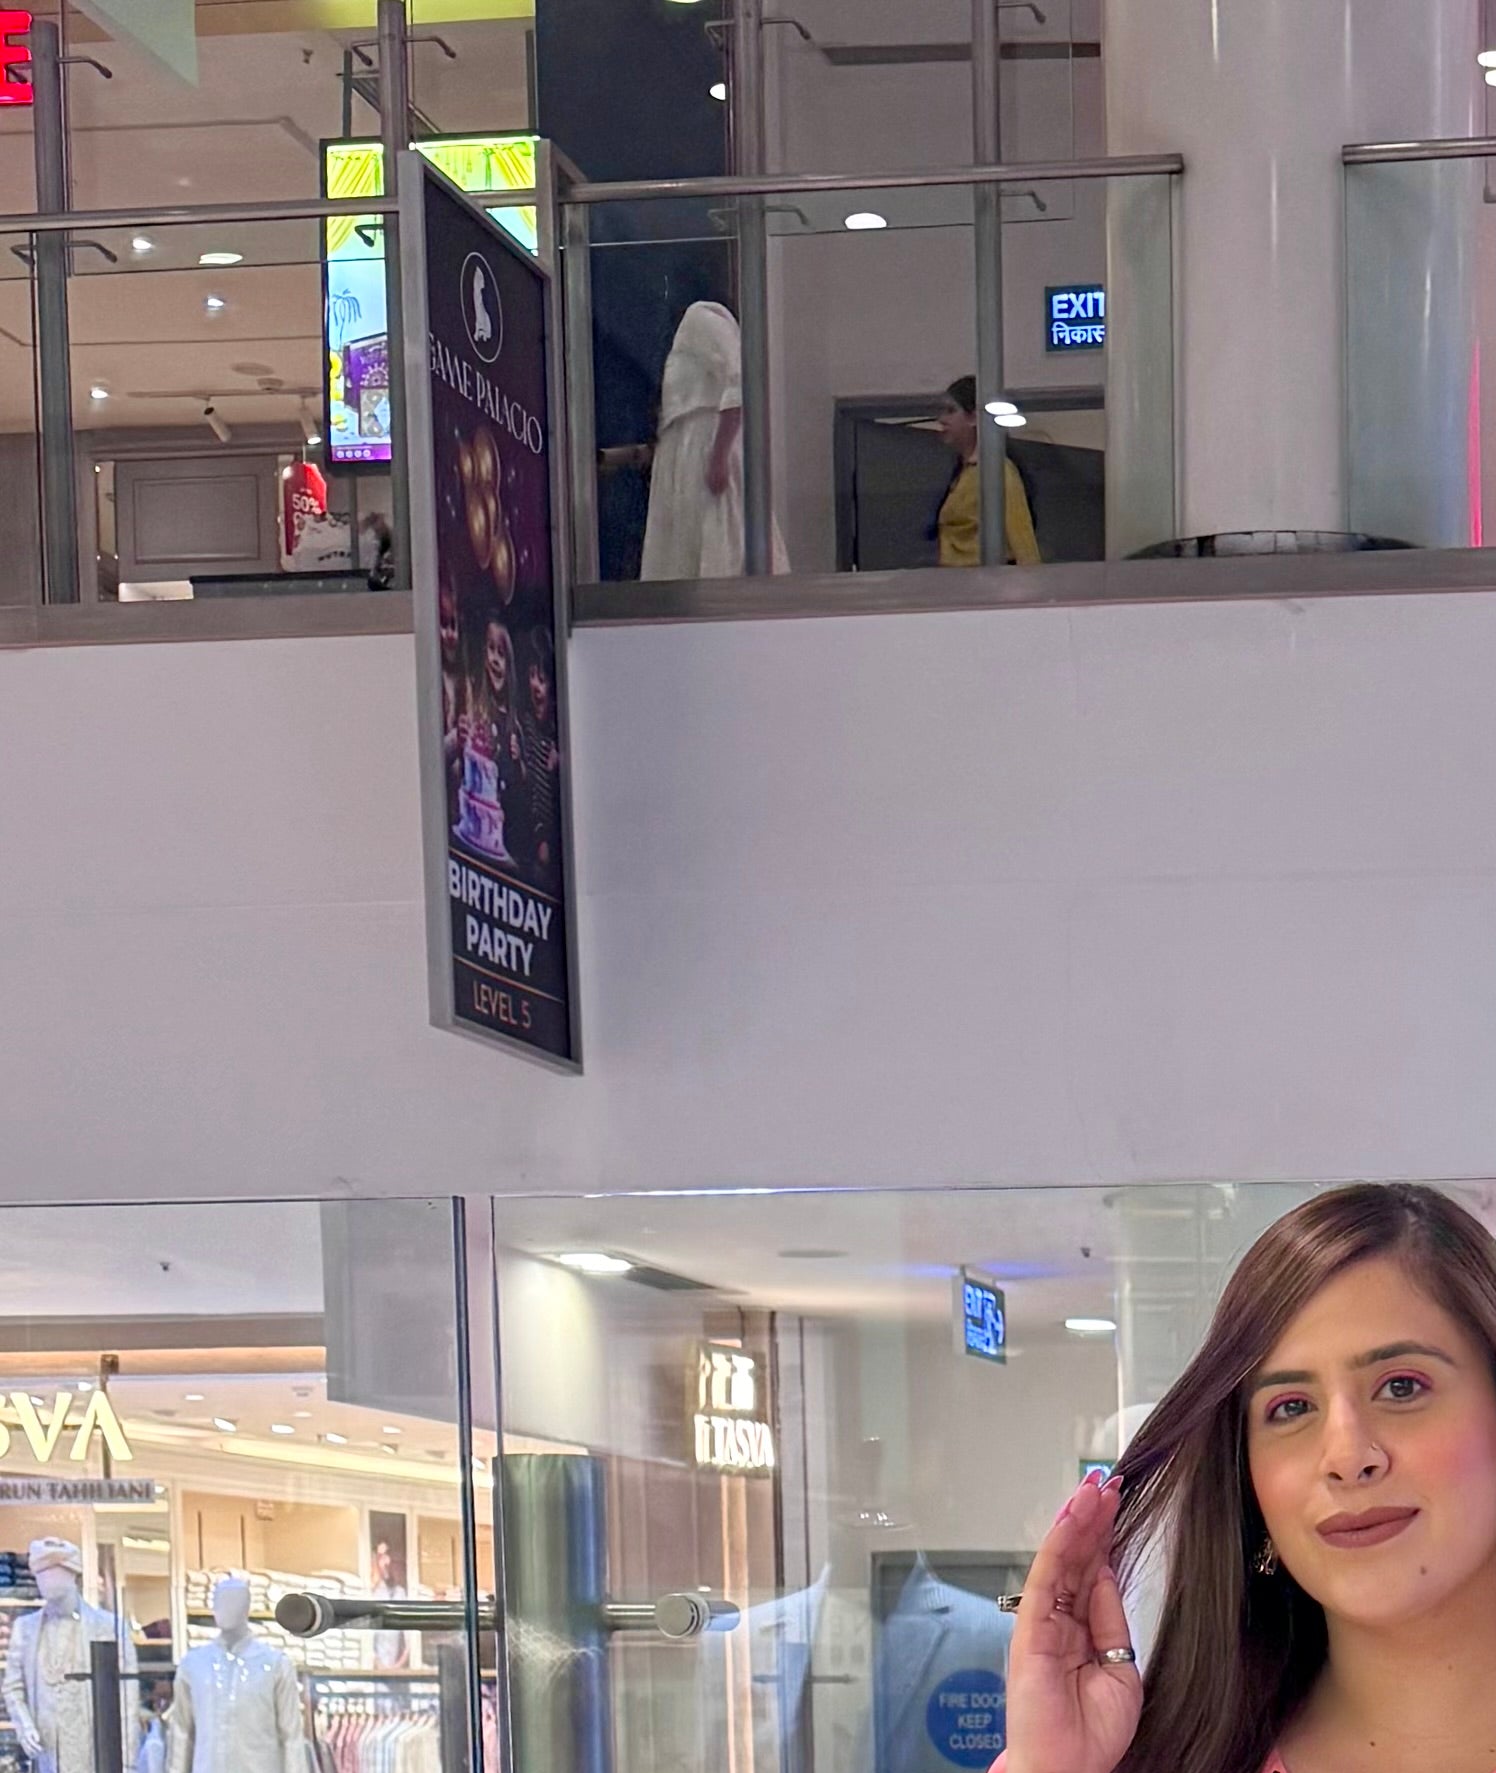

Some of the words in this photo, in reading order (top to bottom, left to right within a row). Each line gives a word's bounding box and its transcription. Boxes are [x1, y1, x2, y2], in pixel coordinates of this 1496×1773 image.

[1052, 292, 1105, 318] EXIT
[476, 371, 543, 454] PALACIO
[449, 859, 553, 941] BIRTHDAY
[466, 914, 534, 977] PARTY
[473, 980, 518, 1026] LEVEL
[521, 1001, 532, 1029] 5
[939, 1693, 968, 1708] FIRE
[958, 1714, 992, 1728] KEEP
[949, 1734, 1002, 1749] CLOSED
